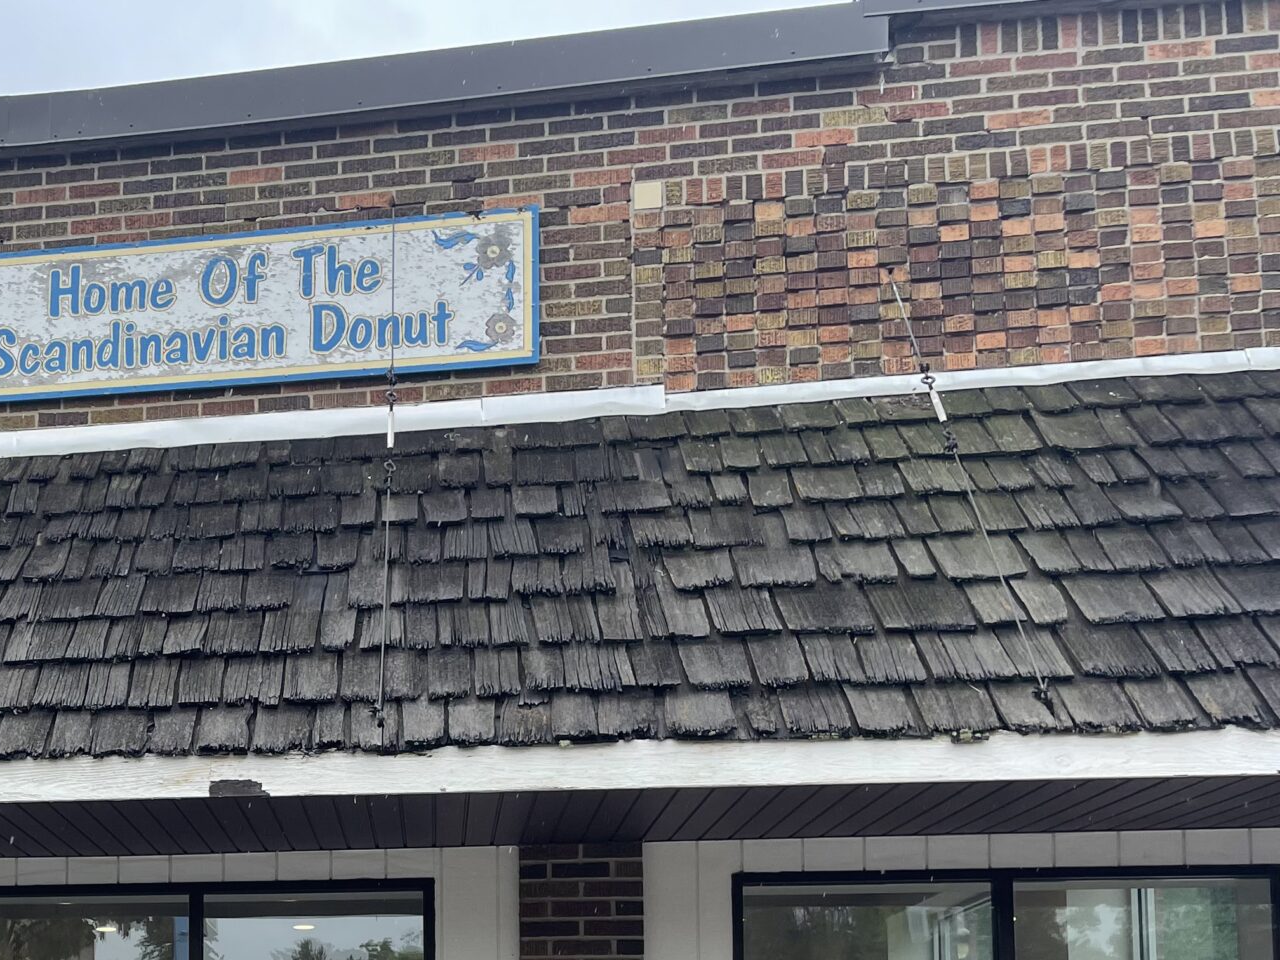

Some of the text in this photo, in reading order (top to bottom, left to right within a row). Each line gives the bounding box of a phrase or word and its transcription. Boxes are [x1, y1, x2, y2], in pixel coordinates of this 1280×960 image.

[47, 243, 384, 319] Home Of The
[309, 300, 455, 355] Donut
